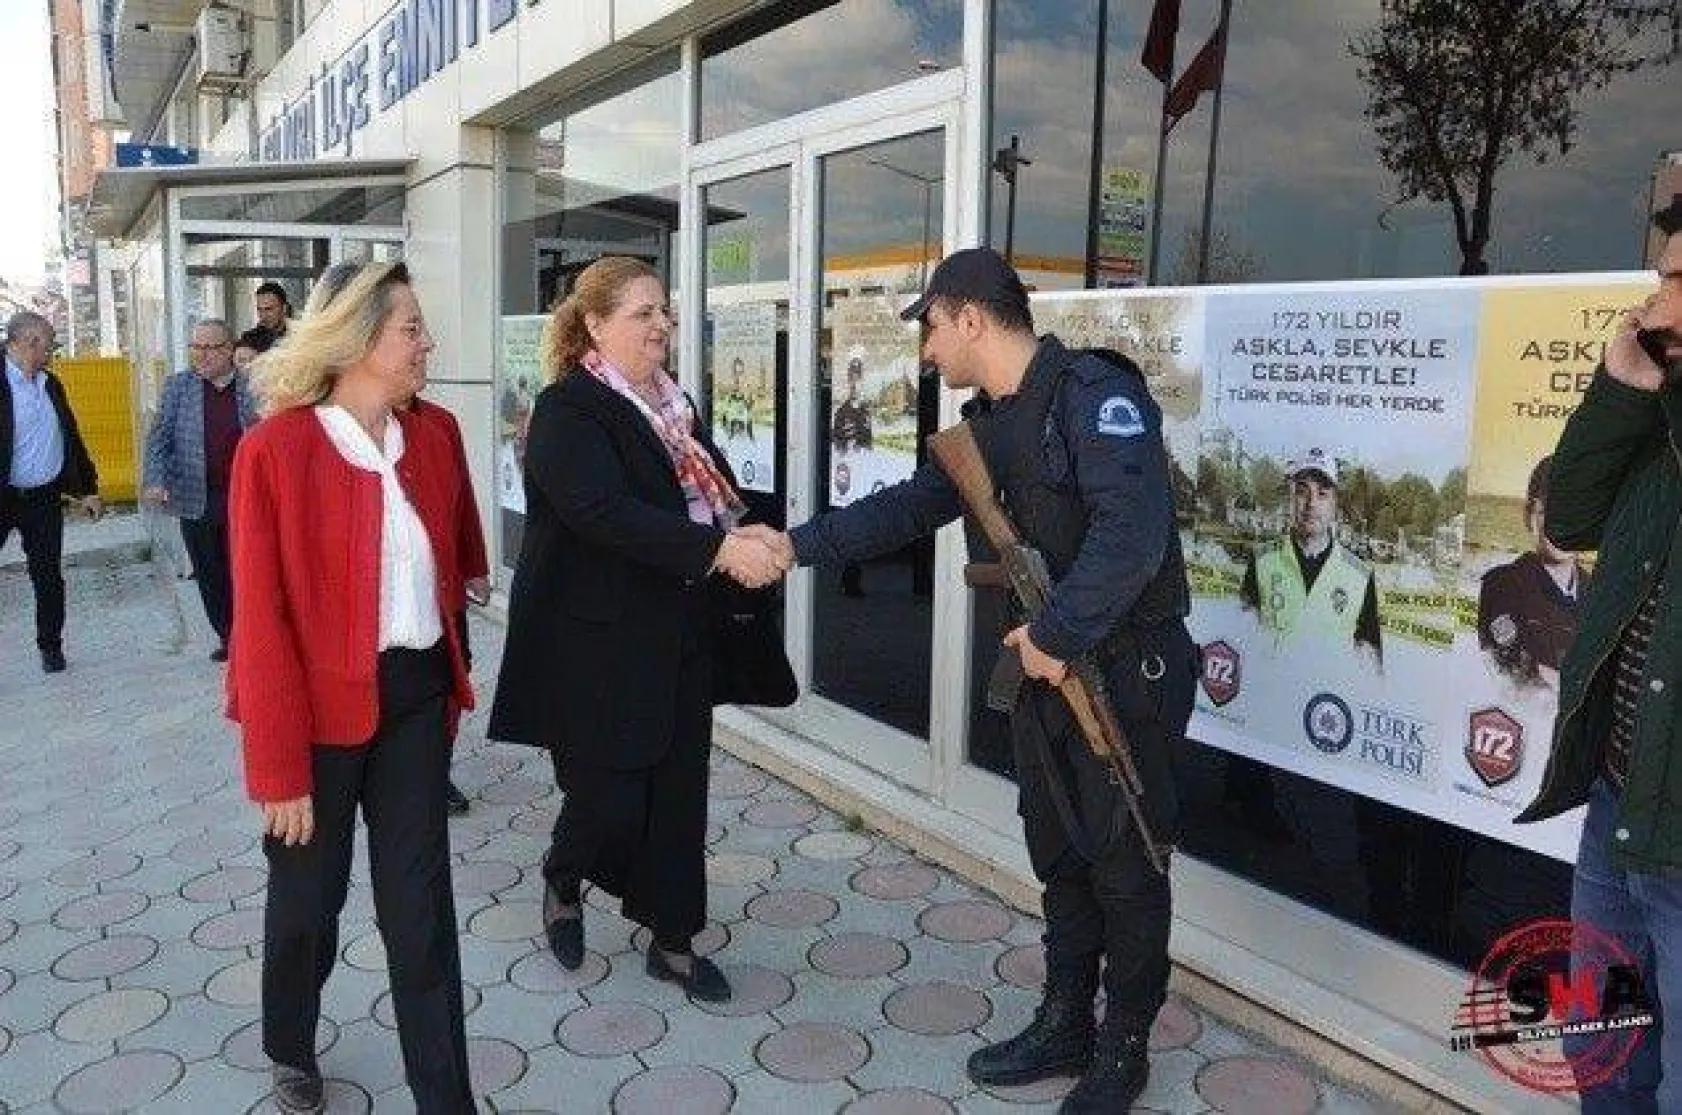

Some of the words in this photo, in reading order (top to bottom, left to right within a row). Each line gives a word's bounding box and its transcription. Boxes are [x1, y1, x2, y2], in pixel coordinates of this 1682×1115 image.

[1273, 311, 1309, 329] 172
[1316, 311, 1402, 332] YILDIR
[1581, 309, 1631, 330] 17
[1334, 338, 1447, 359] SEVKLE
[1252, 361, 1416, 386] CESARETLE!
[1228, 387, 1270, 403] TÜRK
[1337, 393, 1373, 409] HER
[1379, 396, 1445, 414] YERDE
[1474, 726, 1515, 761] 172
